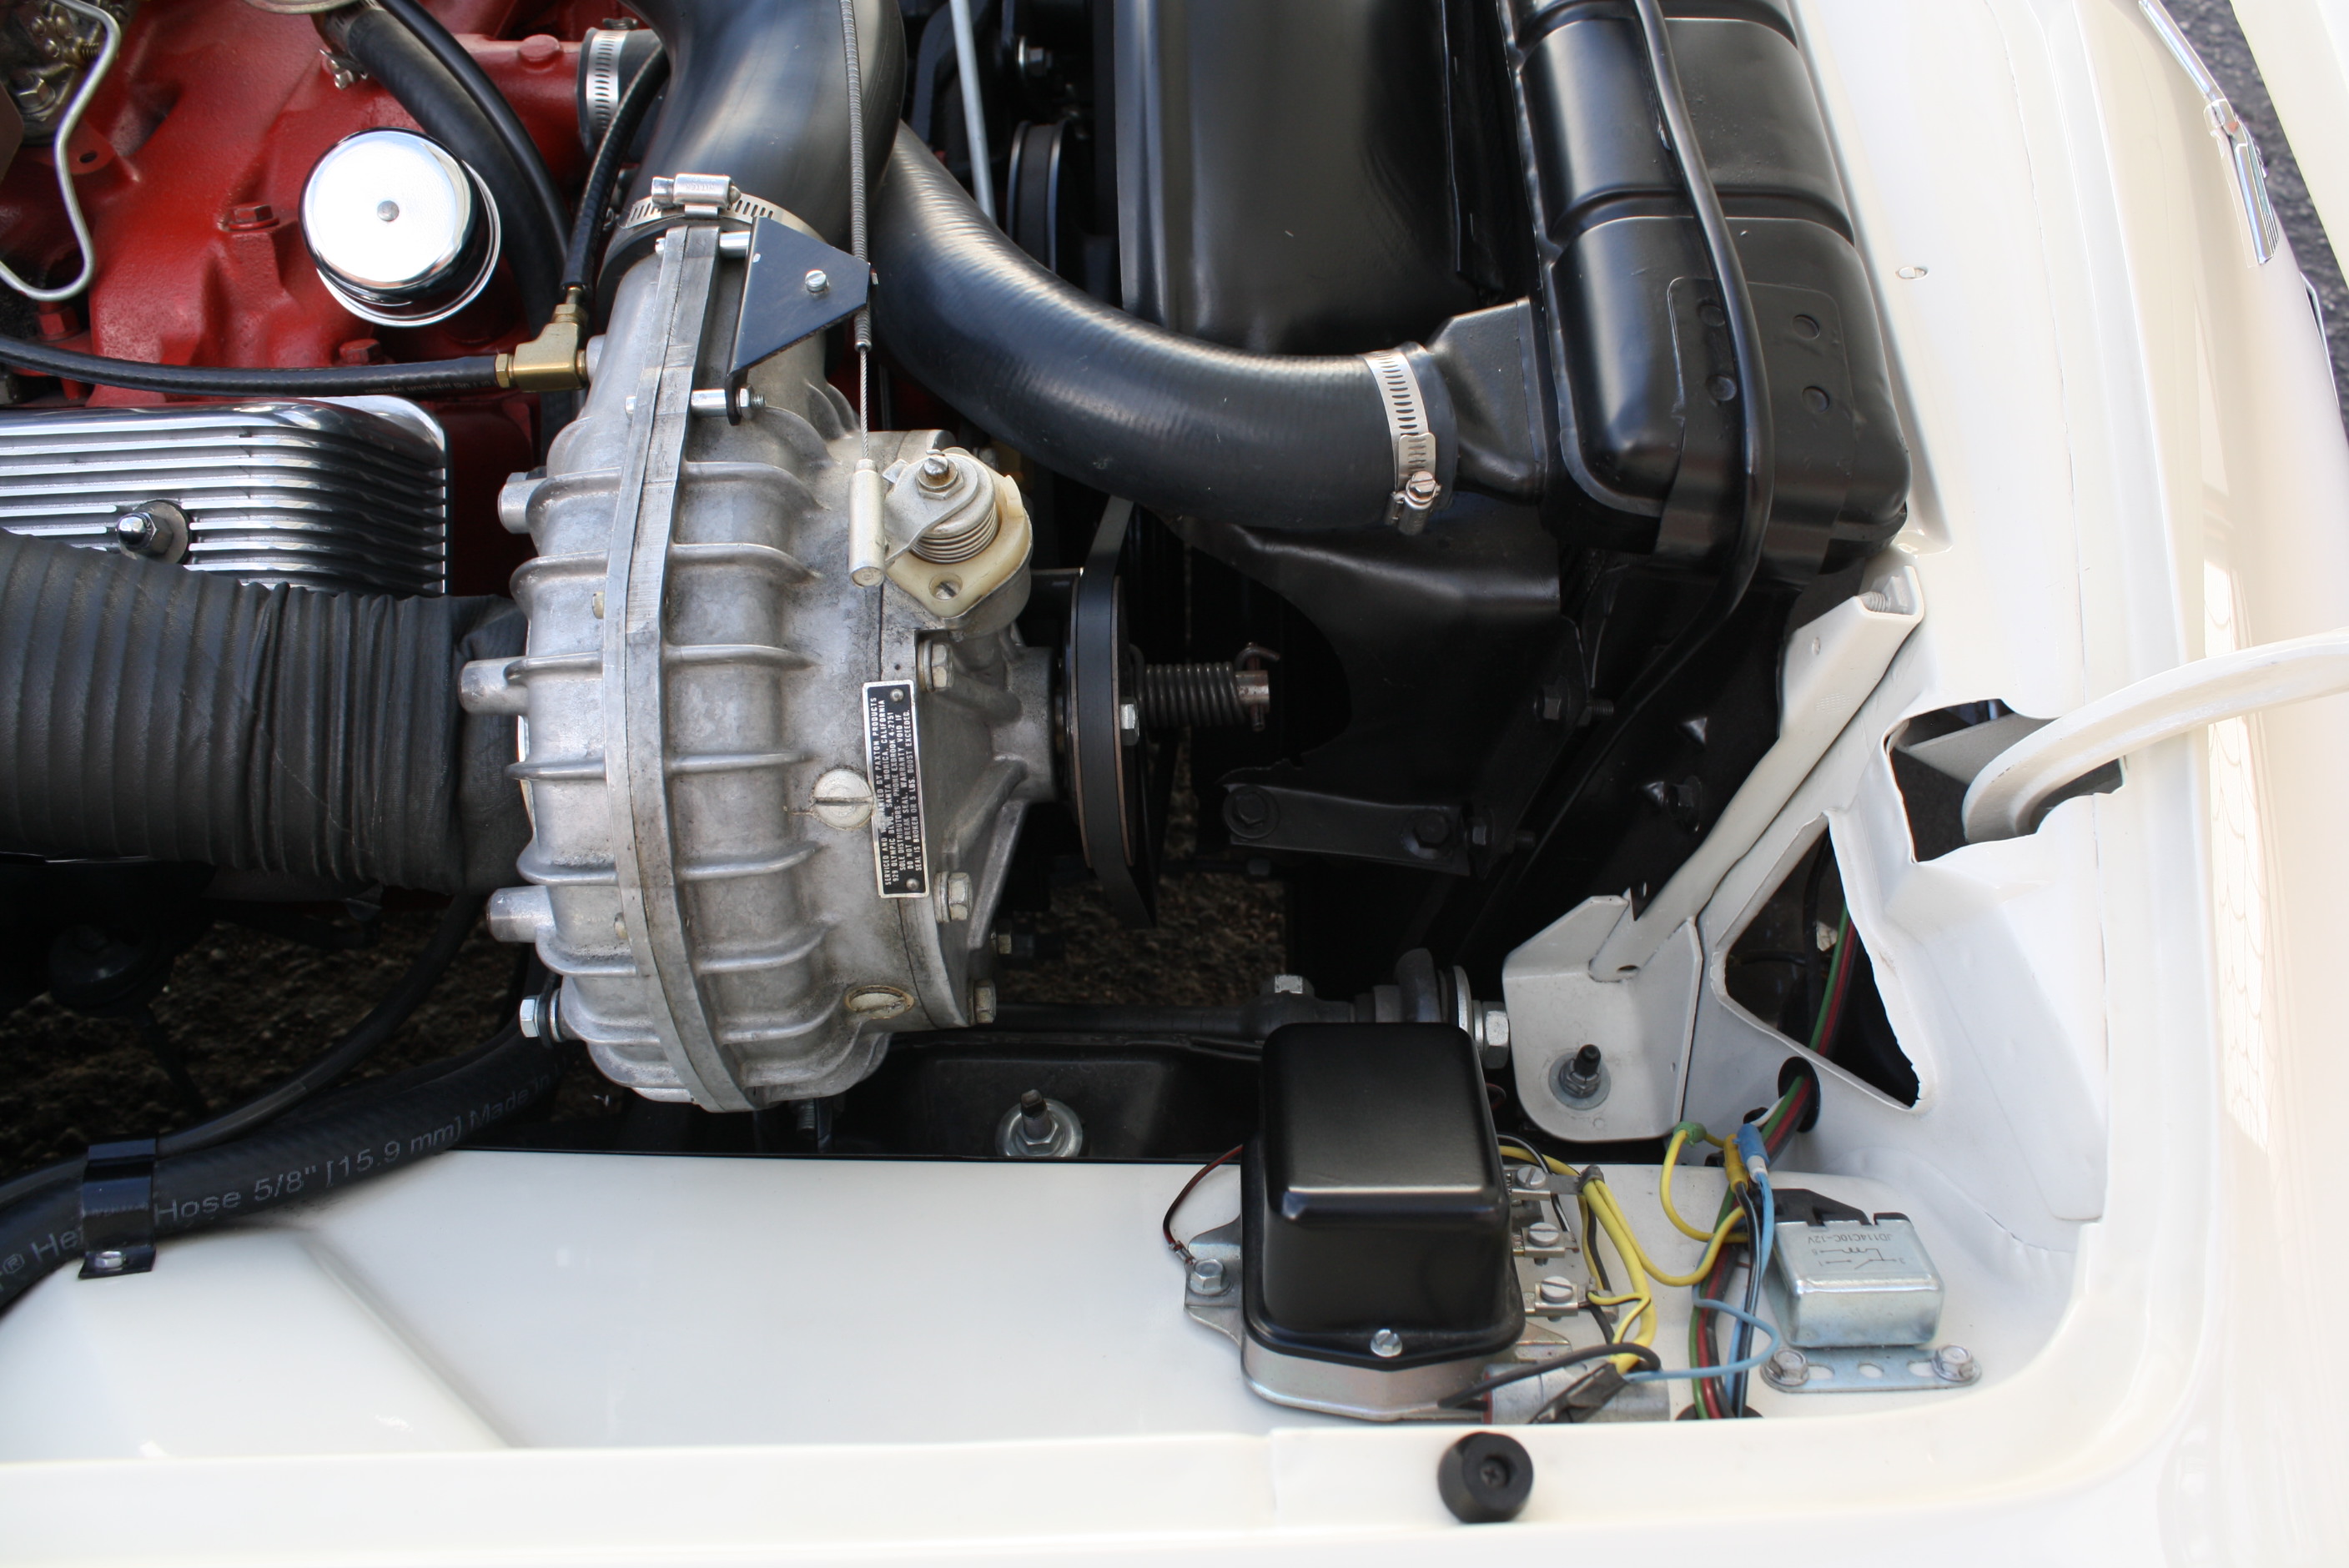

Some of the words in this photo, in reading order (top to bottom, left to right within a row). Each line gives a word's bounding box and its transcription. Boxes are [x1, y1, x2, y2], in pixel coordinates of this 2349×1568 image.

[870, 697, 878, 736] PRODUCTS
[878, 701, 888, 743] CALIFORNIA
[873, 741, 882, 770] PAXTON
[889, 740, 898, 771] EXBROOK
[898, 747, 907, 787] WARRANTY
[906, 751, 914, 773] BOOST
[876, 775, 883, 784] BY
[884, 784, 893, 807] SANTA
[910, 804, 917, 812] OR
[877, 789, 886, 832] WRANTED
[895, 806, 904, 853] DISTRIBUTORS
[911, 817, 919, 842] BROKEN
[883, 856, 891, 885] SERVICED
[907, 861, 913, 869] DO
[153, 1199, 241, 1225] Hose
[254, 1165, 317, 1202] 5/8"
[469, 1088, 529, 1131] Made
